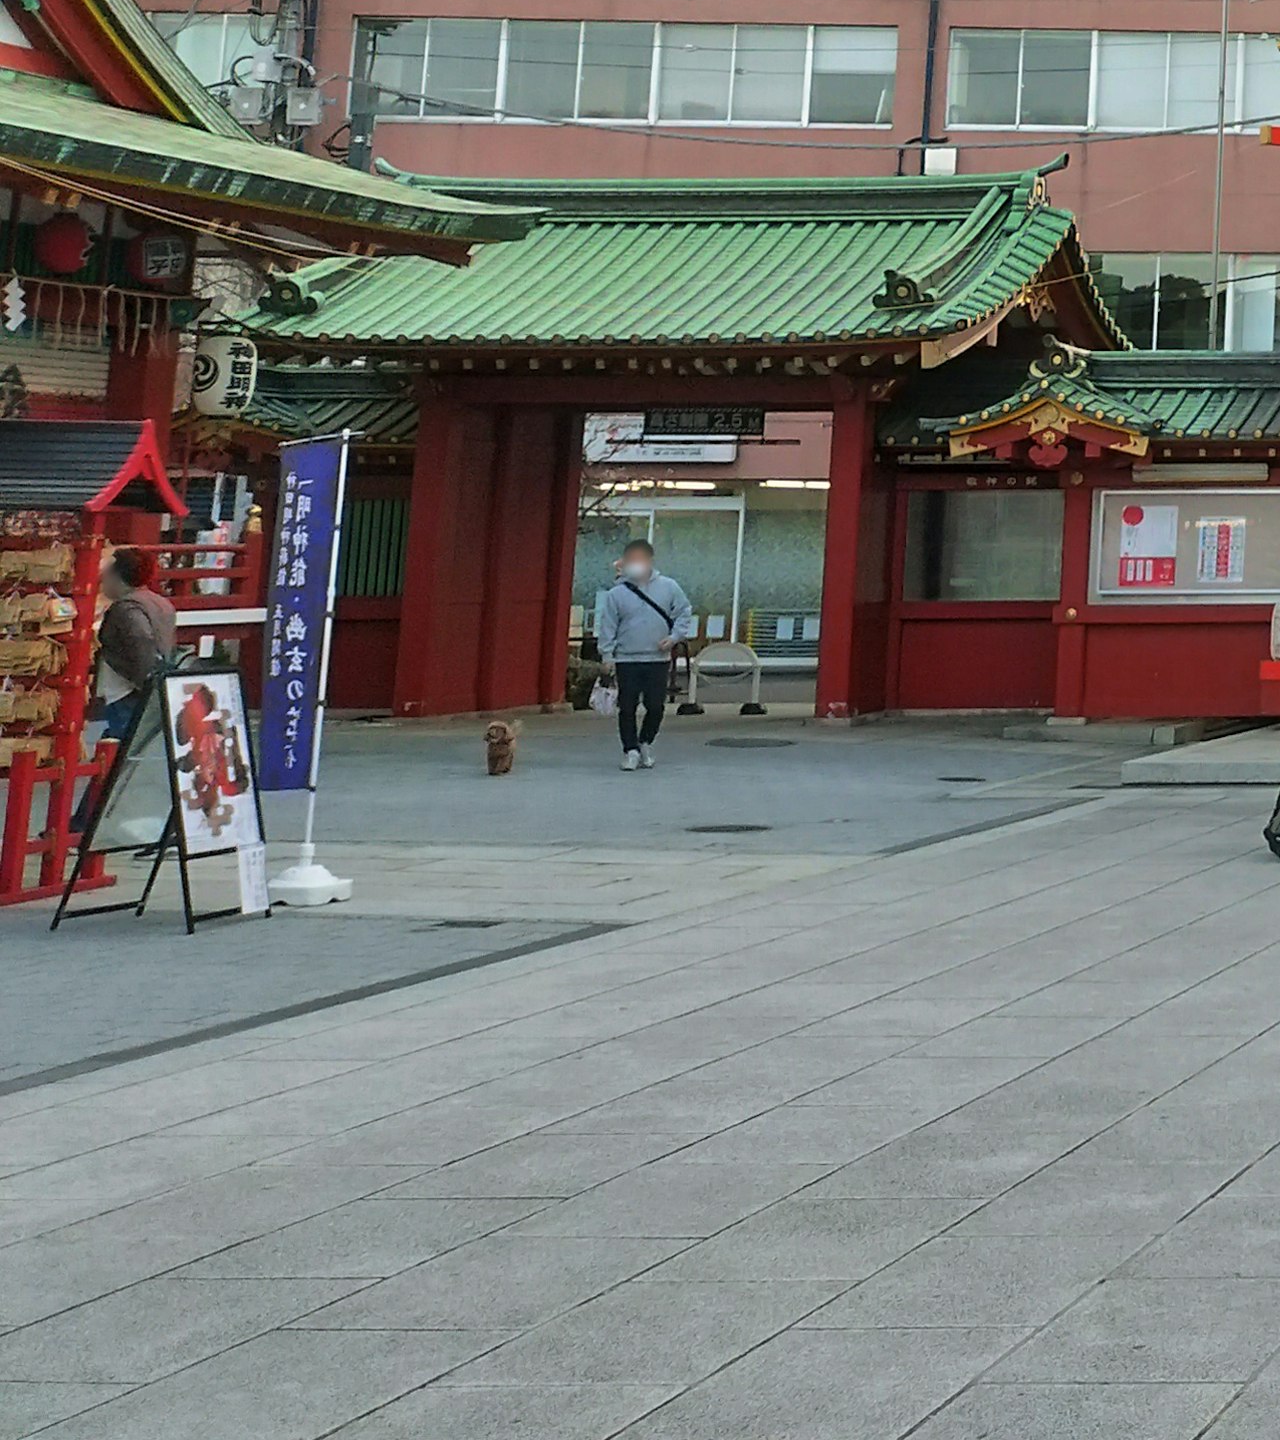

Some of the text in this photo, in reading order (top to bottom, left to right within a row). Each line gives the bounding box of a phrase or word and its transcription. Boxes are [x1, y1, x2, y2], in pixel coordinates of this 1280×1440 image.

[219, 342, 254, 409] 神田明神
[714, 413, 743, 428] 2.5
